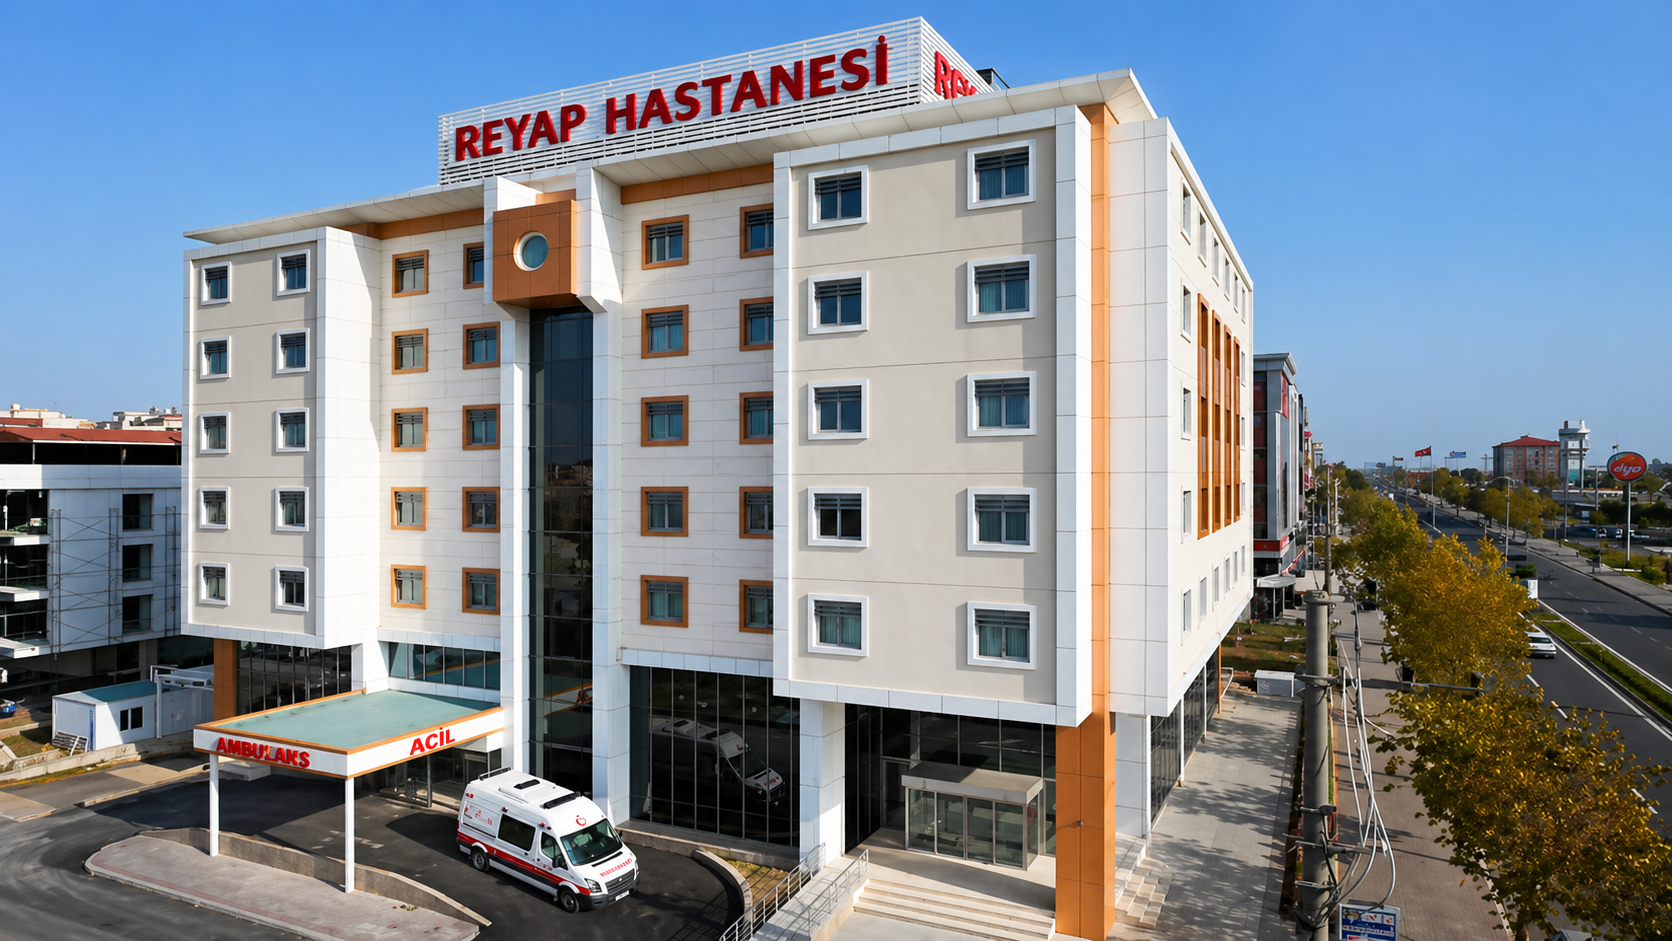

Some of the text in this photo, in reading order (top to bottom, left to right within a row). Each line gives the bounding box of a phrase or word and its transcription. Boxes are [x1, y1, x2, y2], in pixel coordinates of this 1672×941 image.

[455, 35, 889, 162] REYAP HASTANESİ
[1613, 463, 1642, 477] dyo
[409, 727, 456, 756] ACİL
